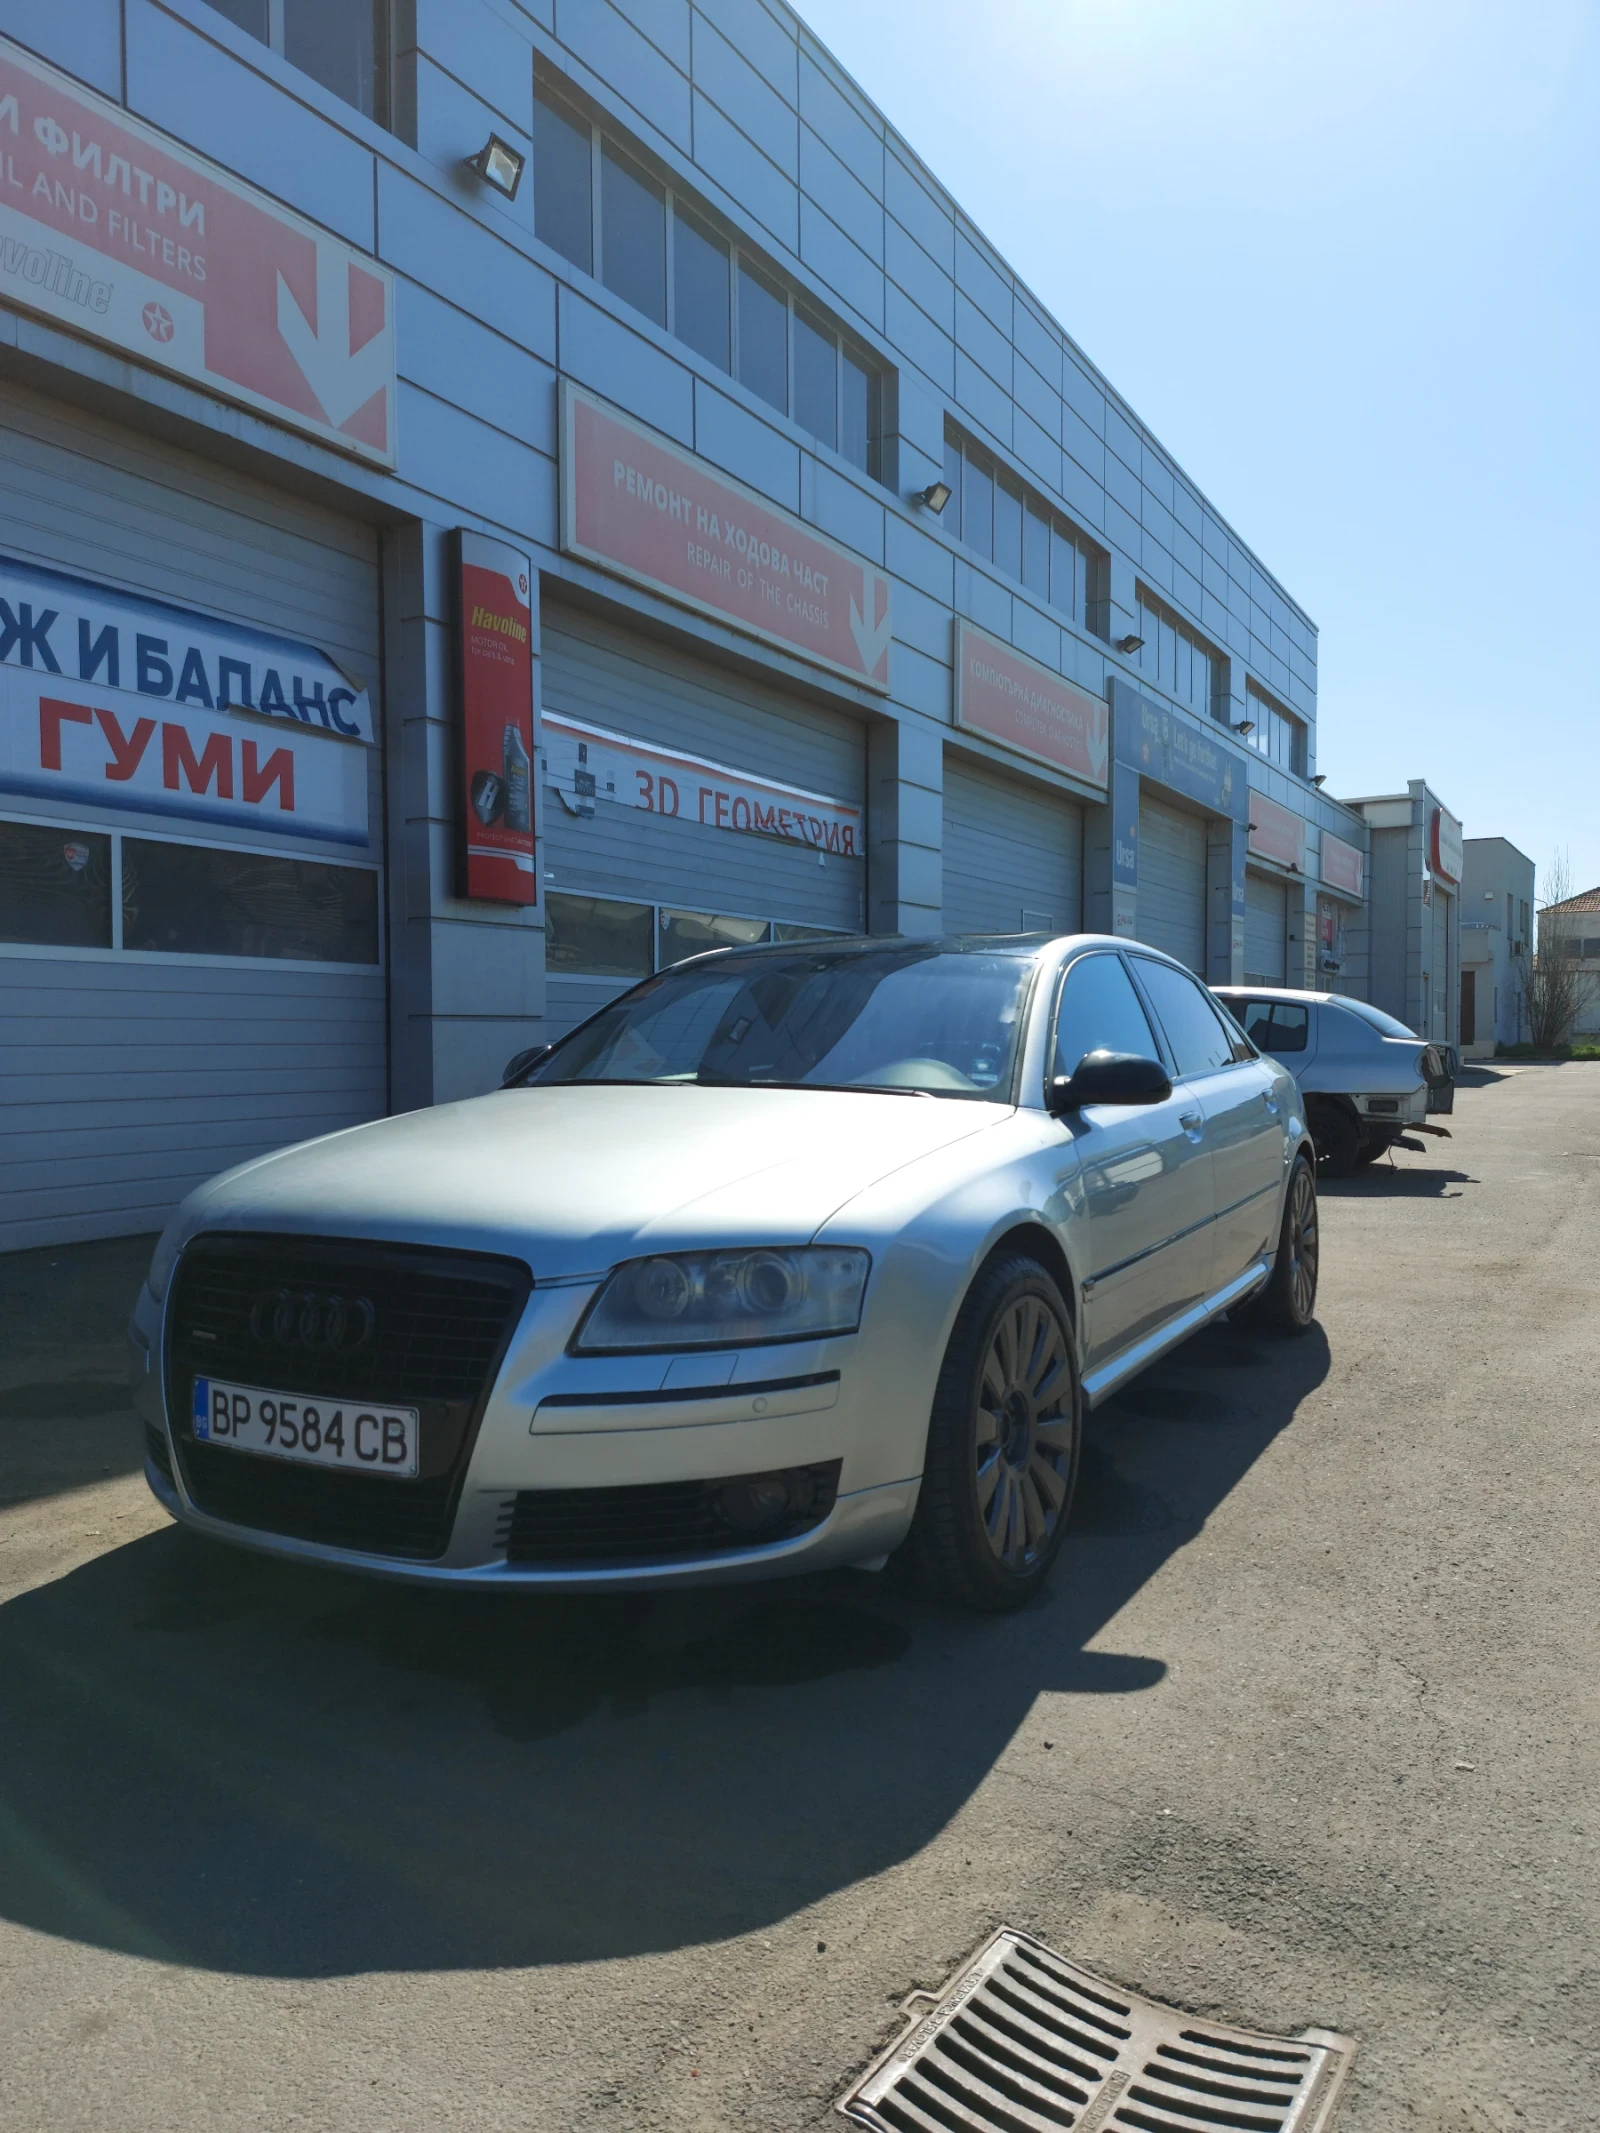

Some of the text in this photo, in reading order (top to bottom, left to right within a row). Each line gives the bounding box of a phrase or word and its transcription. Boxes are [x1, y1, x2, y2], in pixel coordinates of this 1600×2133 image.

[34, 116, 205, 236] ФИЛТРИ
[32, 172, 98, 224] AND
[108, 208, 207, 282] FILTERS
[0, 234, 112, 314] voline
[613, 459, 829, 598] РЕМОНТ НА ХОДОВА ЧАСТ
[471, 606, 527, 644] Havoline
[687, 541, 829, 629] REPAIR OF THE CHASSIS
[78, 618, 120, 688] И
[136, 633, 361, 737] БАЛАНС
[471, 635, 509, 654] MOTOR OIL
[471, 646, 480, 656] for
[969, 657, 1030, 705] КОМПЮТЪРНА
[39, 696, 296, 812] ГУМИ
[635, 769, 679, 818] 3D
[698, 787, 856, 856] ГЕОМЕТРИЯ
[1116, 839, 1135, 870] Ursa
[259, 1400, 345, 1458] 9584
